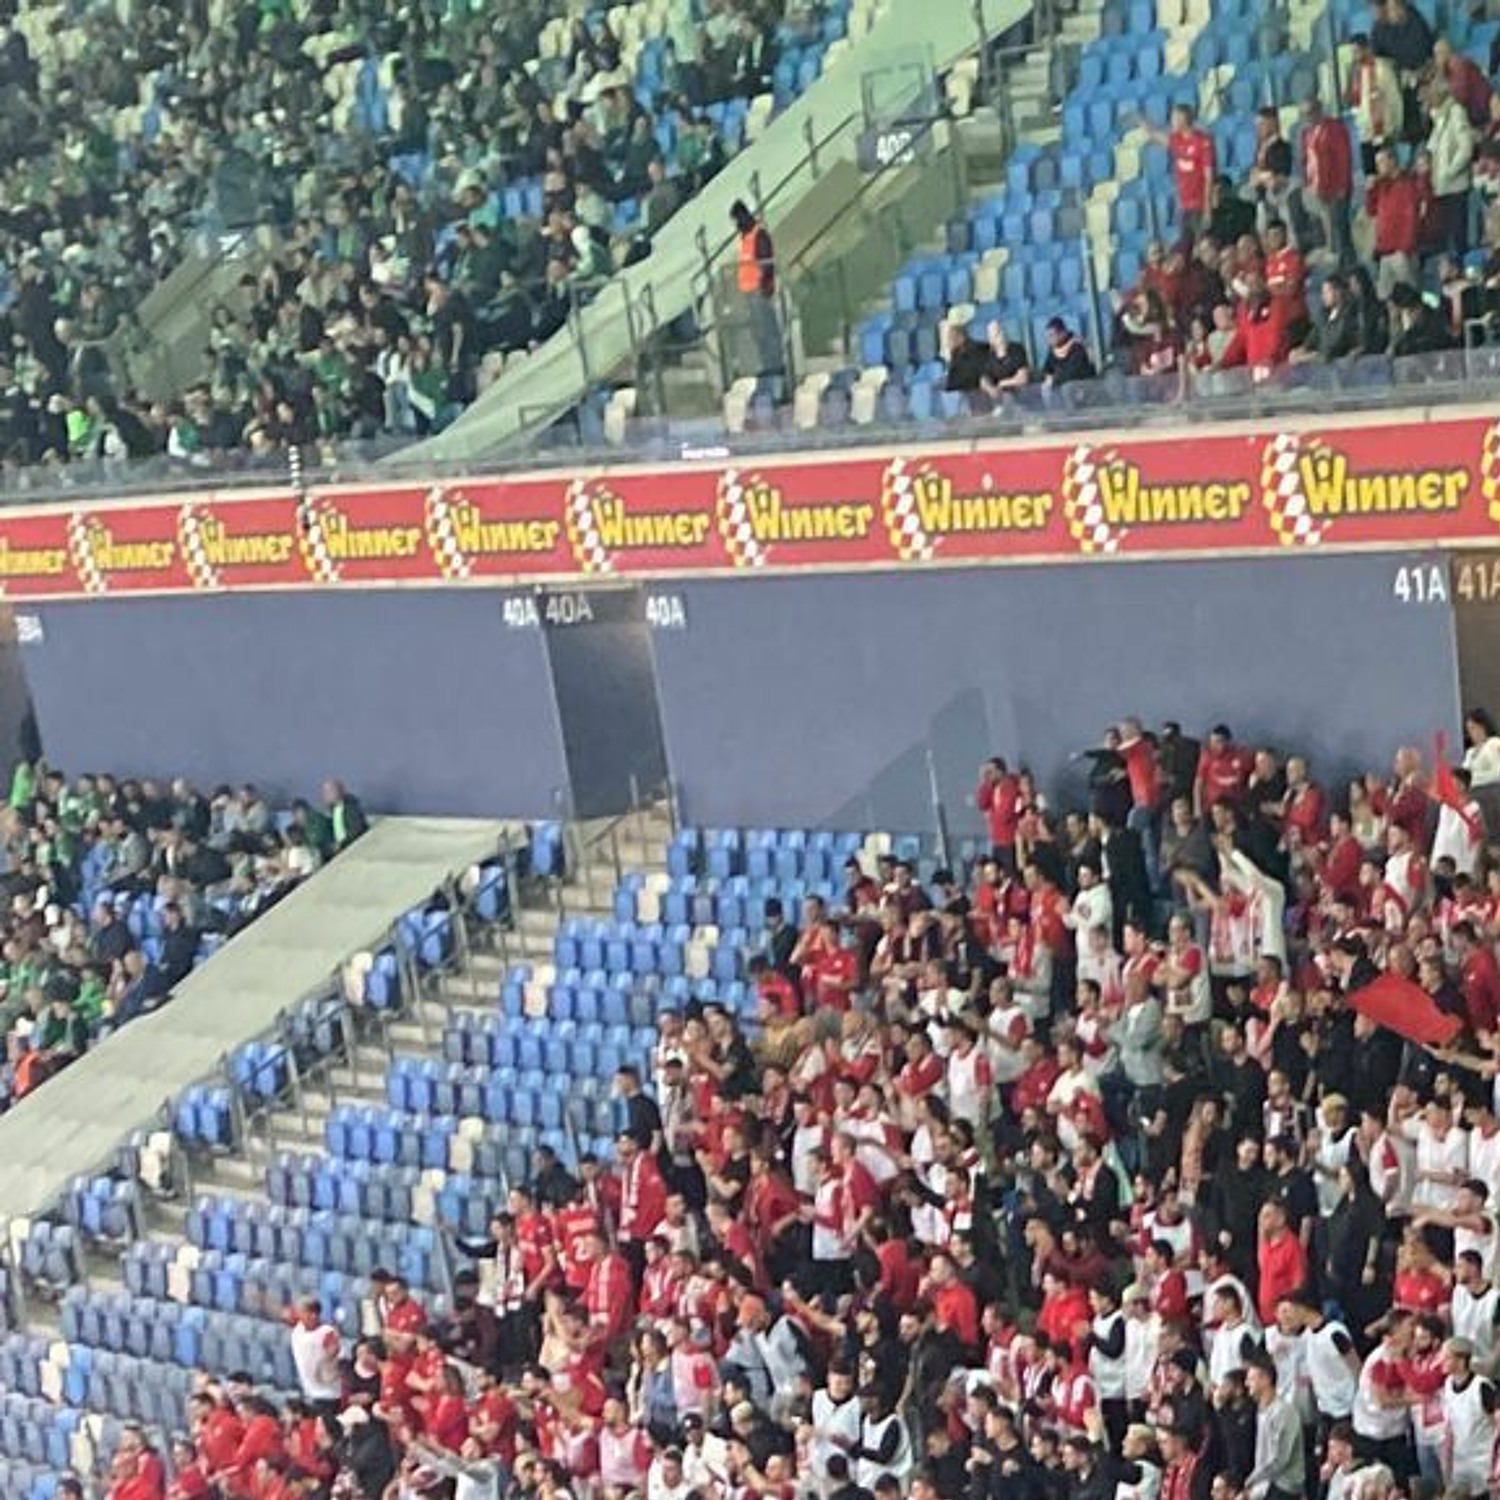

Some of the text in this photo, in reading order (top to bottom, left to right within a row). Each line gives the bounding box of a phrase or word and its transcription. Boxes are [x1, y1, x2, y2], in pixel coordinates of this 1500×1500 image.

[914, 477, 1052, 533] Winner
[1099, 461, 1250, 525] Winner
[1297, 450, 1469, 515] Winner
[322, 514, 420, 559] Winner
[450, 506, 559, 553] Winner
[592, 498, 709, 547] Winner
[744, 488, 873, 540] Winner
[1394, 566, 1447, 602] 41A
[503, 598, 540, 627] 40A
[546, 594, 595, 625] 40A
[645, 596, 686, 627] 40A
